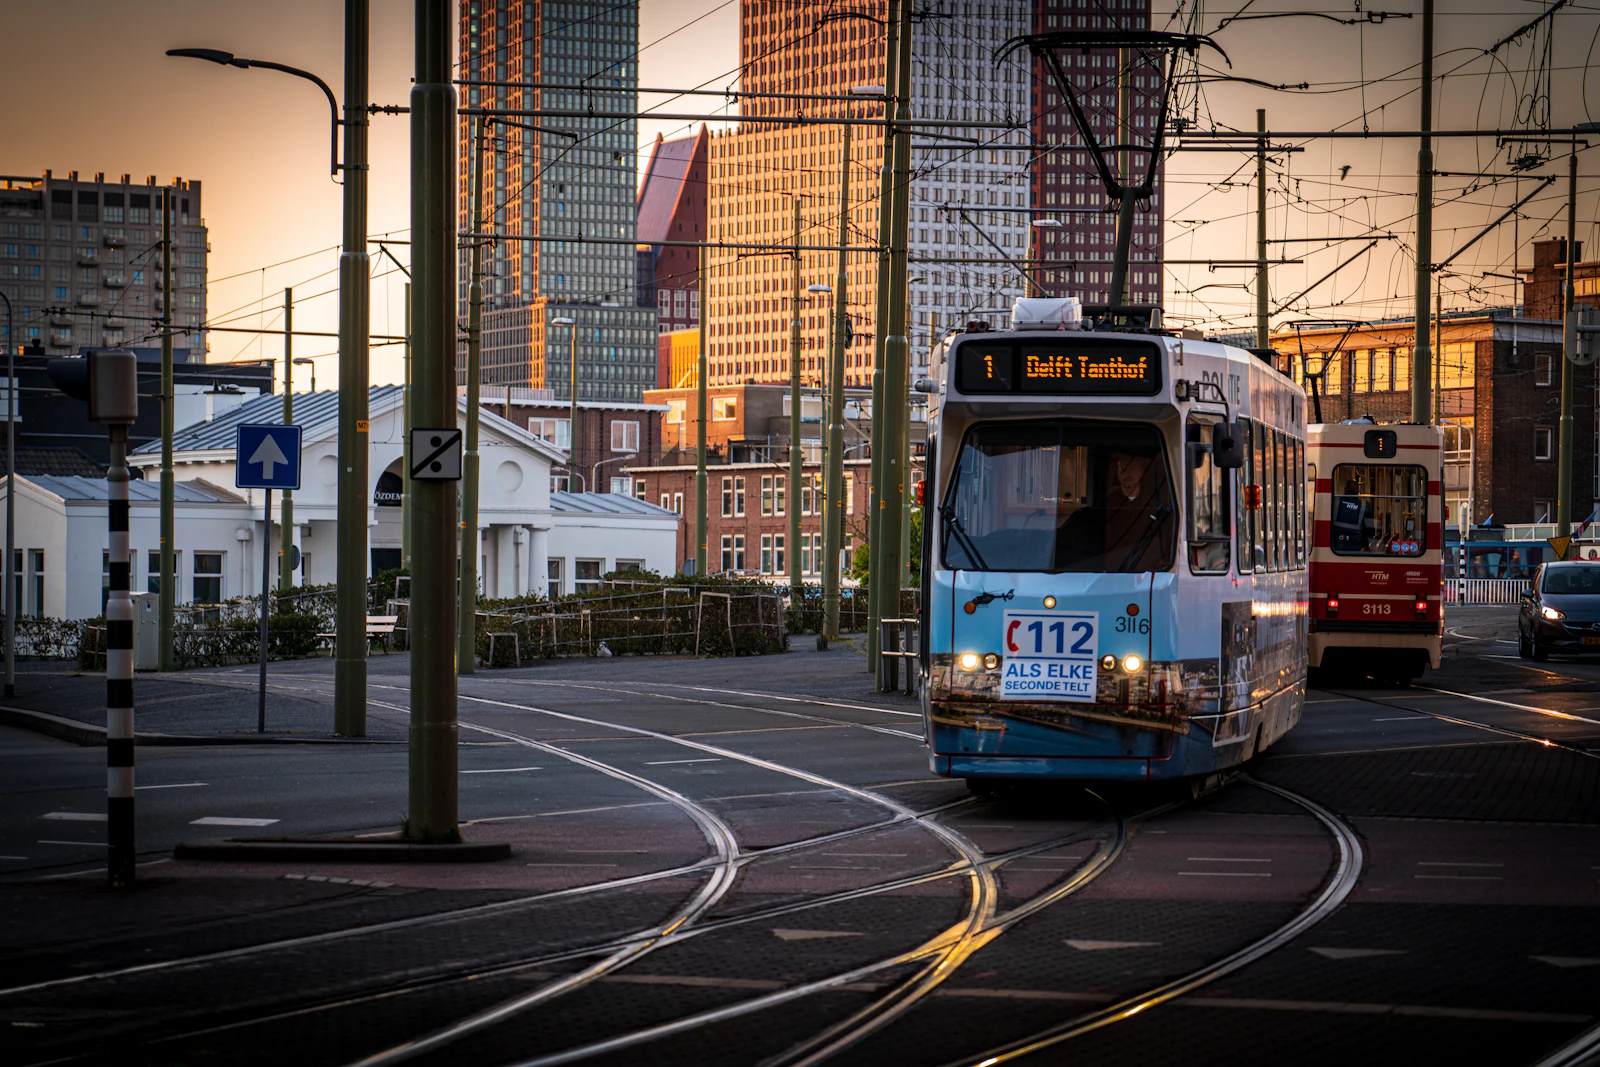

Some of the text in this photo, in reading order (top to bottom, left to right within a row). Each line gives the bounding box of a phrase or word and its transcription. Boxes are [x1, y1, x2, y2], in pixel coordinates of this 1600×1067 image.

[983, 355, 1147, 378] 1 Delft Tanthof
[1377, 437, 1383, 451] 1
[1362, 604, 1391, 615] 3113
[1115, 616, 1150, 635] 3116
[1027, 620, 1094, 655] 112
[1005, 663, 1093, 680] ALS ELKE
[1005, 680, 1090, 692] SECONDE TELT
